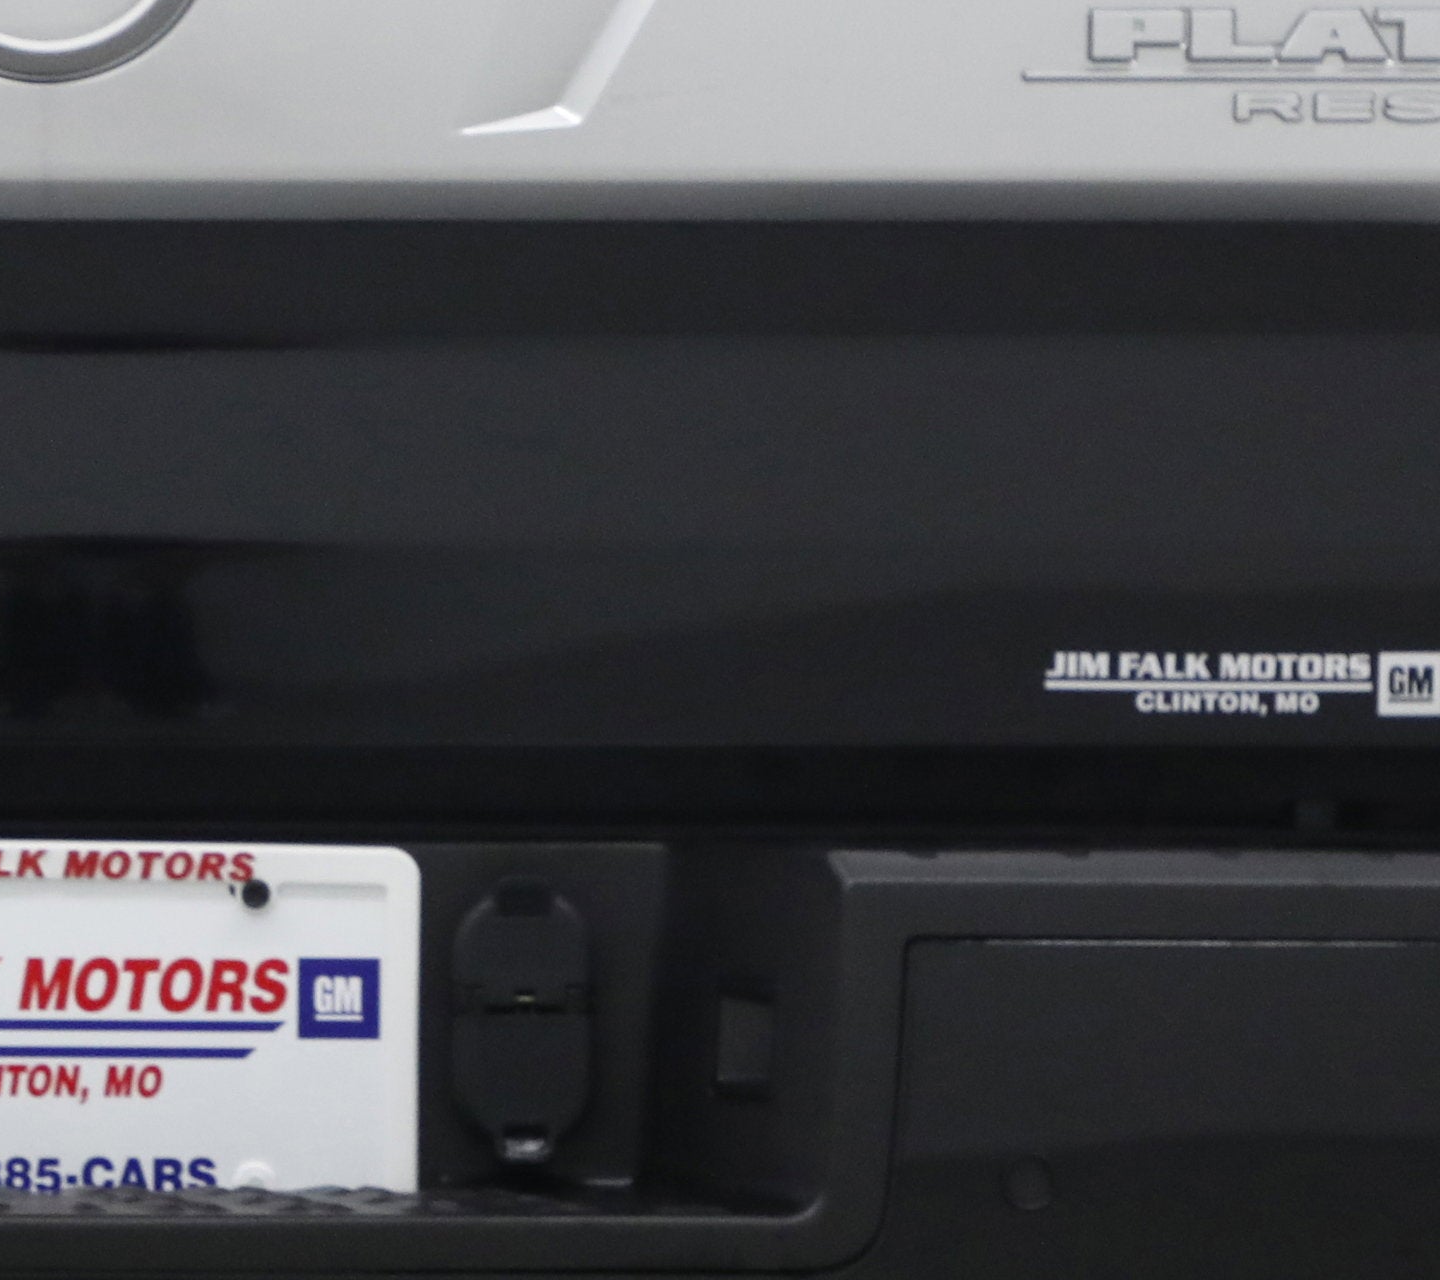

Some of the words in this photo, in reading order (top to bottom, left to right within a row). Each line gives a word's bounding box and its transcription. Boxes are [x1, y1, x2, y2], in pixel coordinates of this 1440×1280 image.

[1046, 652, 1110, 679] JIM
[1119, 652, 1210, 680] FALK
[1218, 653, 1372, 681] MOTORS
[1389, 666, 1434, 696] GM
[1135, 691, 1268, 716] CLINTON,
[1277, 691, 1319, 714] MO
[64, 851, 255, 881] MOTORS
[19, 957, 289, 1013] MOTORS
[313, 976, 363, 1014] GM
[104, 1064, 163, 1099] MO
